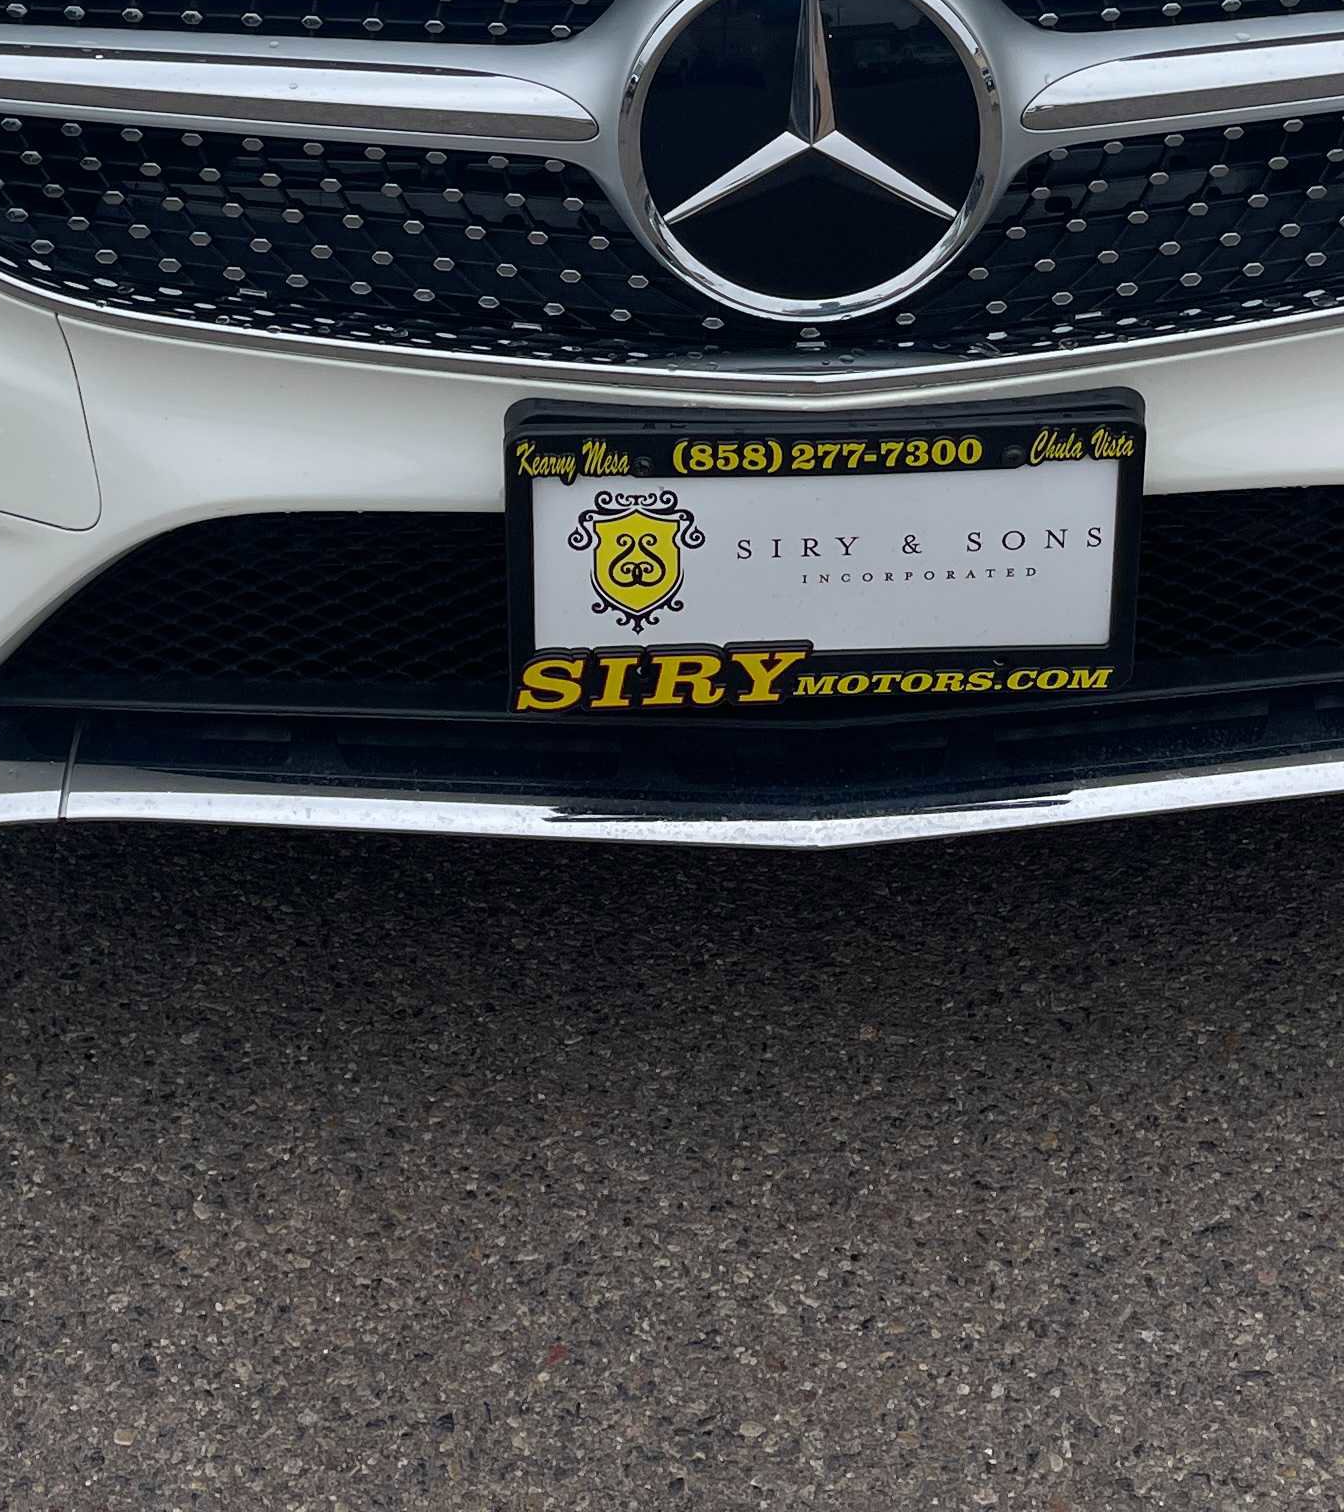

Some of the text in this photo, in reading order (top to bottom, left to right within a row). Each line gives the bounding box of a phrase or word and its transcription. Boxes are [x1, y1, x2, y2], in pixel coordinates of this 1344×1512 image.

[516, 439, 630, 482] Kearny Mesa
[673, 438, 983, 475] (858) 277-7300
[1029, 427, 1135, 465] Chula Vista
[735, 526, 1104, 561] SIRY & SONS
[801, 565, 1038, 585] INCORPORATED
[515, 649, 1114, 713] SIRY MOTORS.COM
